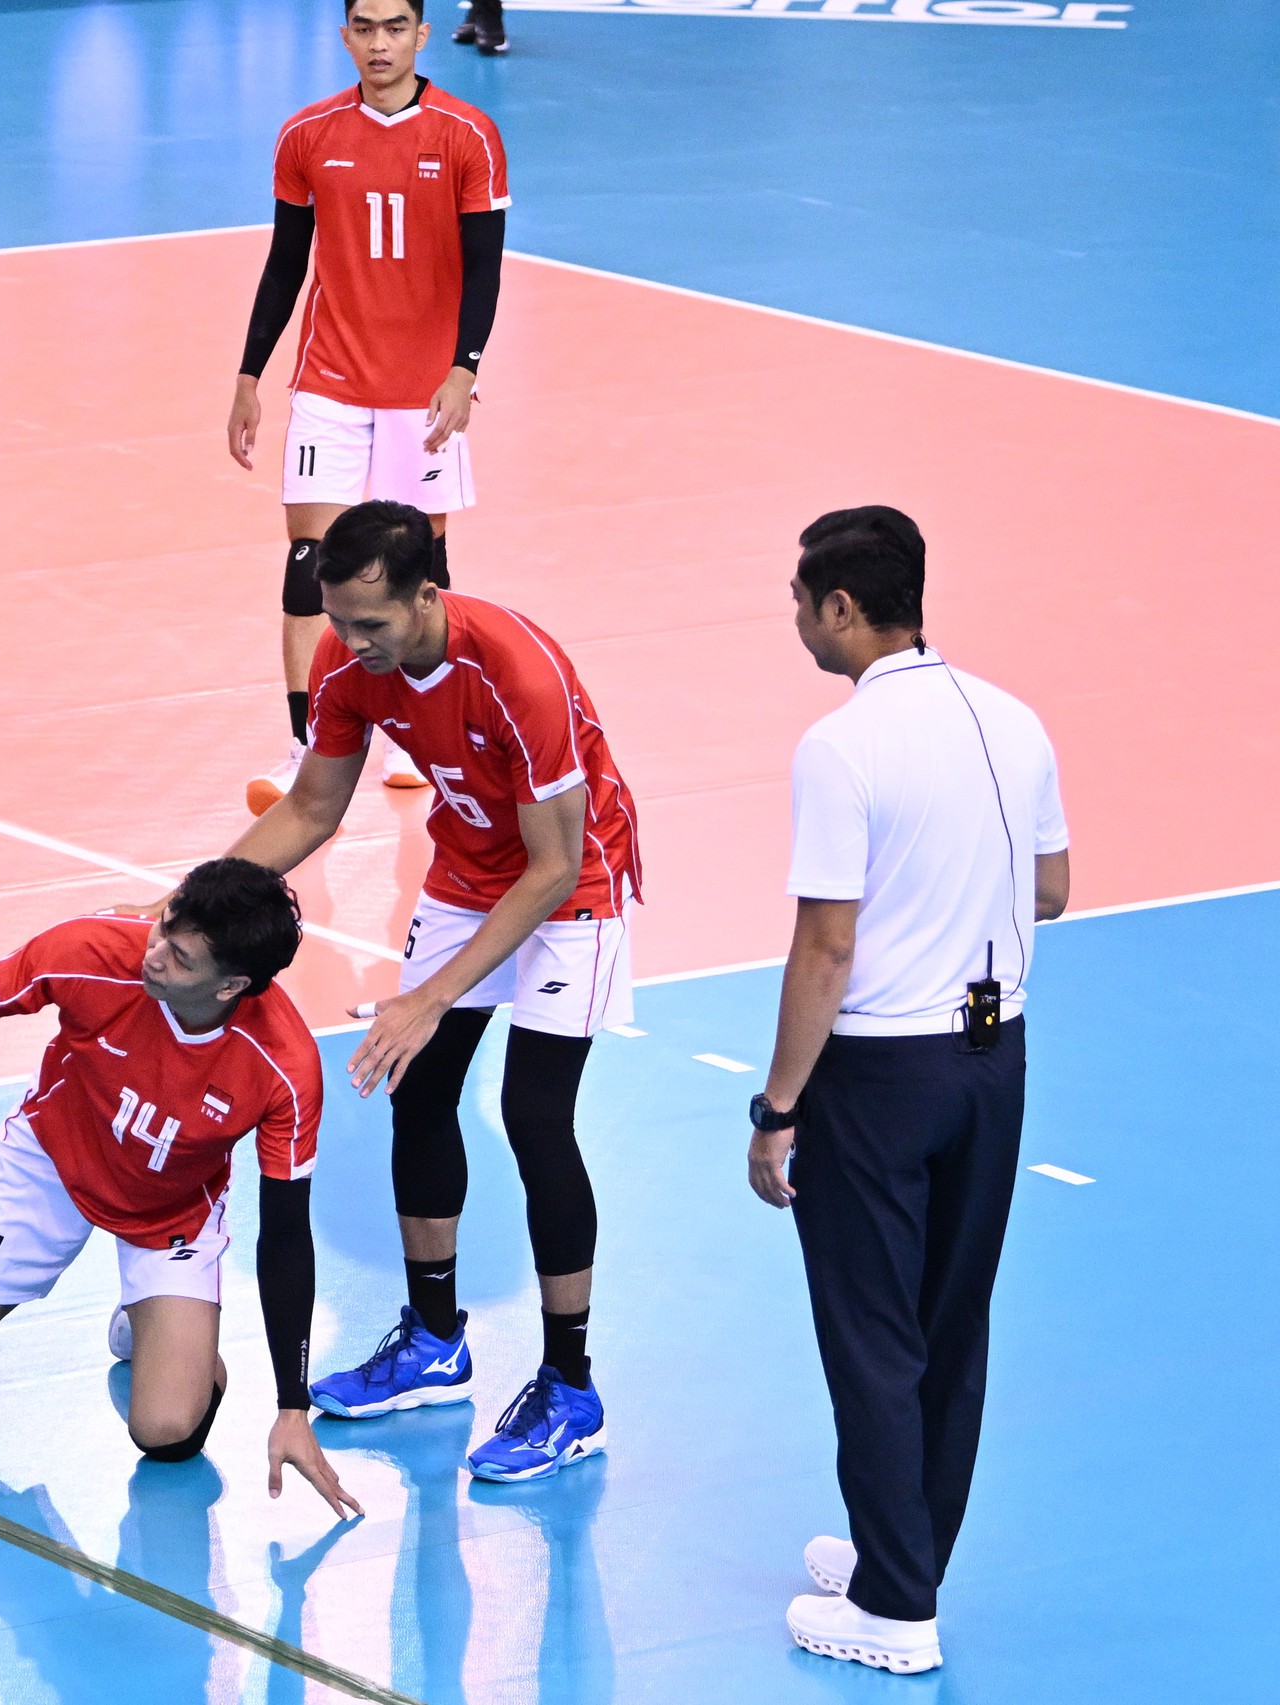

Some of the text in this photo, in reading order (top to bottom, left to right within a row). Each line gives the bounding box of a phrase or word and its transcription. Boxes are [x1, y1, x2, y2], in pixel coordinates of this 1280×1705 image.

[418, 171, 438, 179] INA
[365, 191, 405, 259] 11
[298, 445, 316, 477] 11
[429, 763, 493, 828] 6
[447, 870, 472, 892] ULTRADRY
[404, 918, 422, 960] 6
[111, 1086, 182, 1173] 14
[200, 1105, 224, 1124] INA
